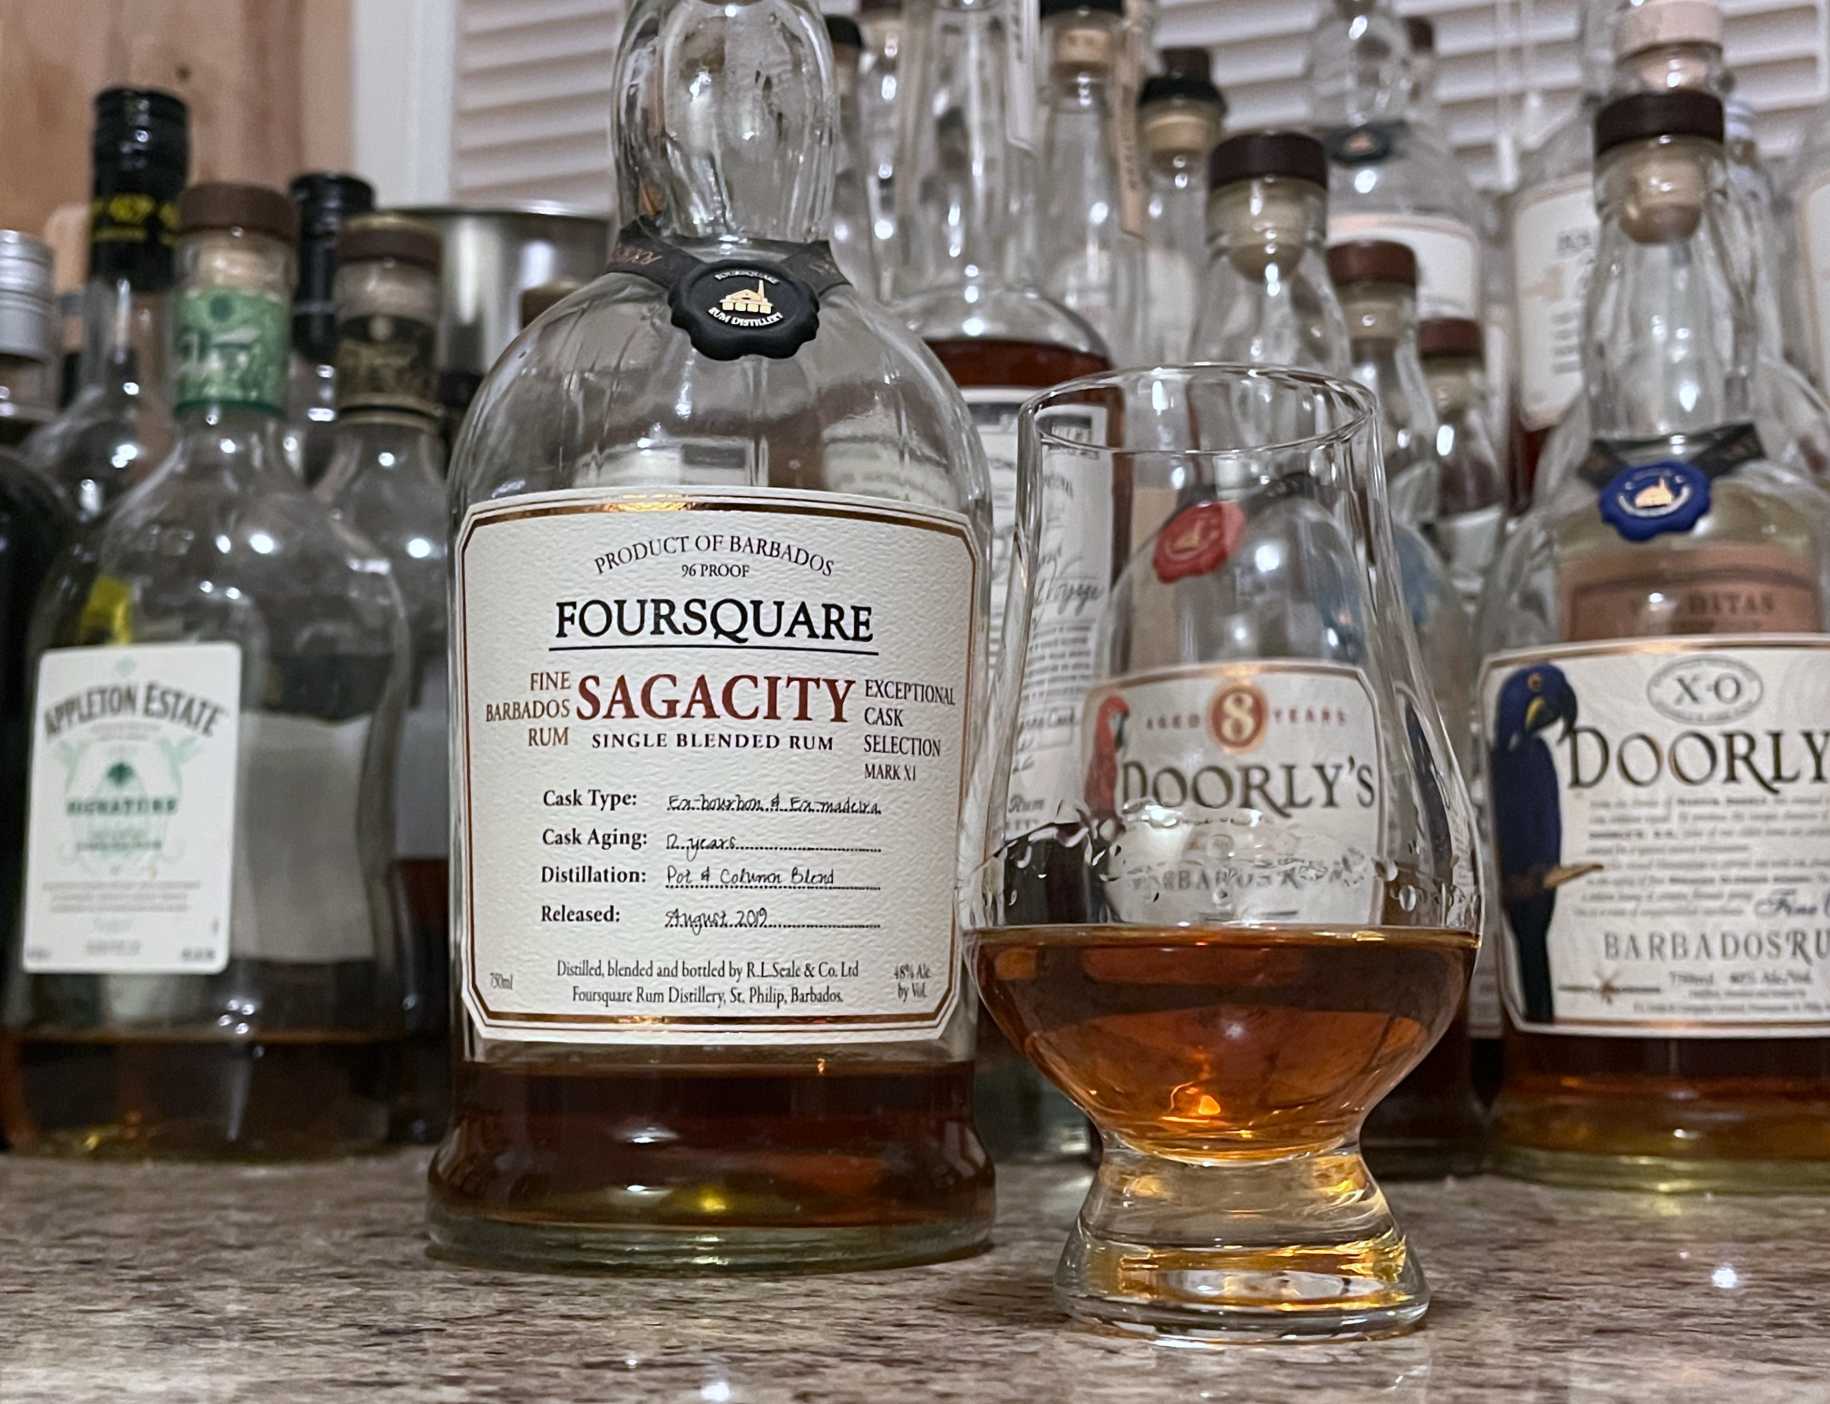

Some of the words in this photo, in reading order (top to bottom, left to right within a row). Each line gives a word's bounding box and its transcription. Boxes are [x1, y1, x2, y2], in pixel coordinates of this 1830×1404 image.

[708, 306, 731, 324] RUM
[594, 535, 690, 574] PRODUCT
[695, 534, 725, 552] OF
[730, 535, 835, 577] BARBADOS
[681, 564, 697, 578] 96
[700, 564, 750, 578] PROOF
[555, 597, 874, 644] FOURSQUARE
[530, 671, 571, 691] FINE
[864, 679, 956, 706] EXCEPTIONAL
[44, 682, 138, 740] APPLETON
[142, 679, 226, 738] ESTATE
[576, 673, 856, 723] SAGACITY
[486, 699, 571, 722] BARBADOS
[864, 707, 905, 728] CASK
[1146, 713, 1201, 730] AGED
[1219, 690, 1256, 742] 8
[1272, 704, 1349, 725] YEARS
[528, 726, 569, 747] RUM
[592, 733, 668, 749] SINGLE
[676, 733, 780, 750] BLENDED
[789, 735, 834, 751] RUM
[863, 734, 941, 757] SELECTION
[864, 763, 901, 780] MARK
[904, 767, 917, 782] XI
[1121, 755, 1376, 819] DOORLY'S
[543, 789, 583, 807] Cask
[588, 789, 638, 811] Type:
[542, 827, 582, 846] Cask
[587, 828, 648, 850] Aging:
[541, 865, 647, 884] Distillation:
[666, 865, 693, 885] Pot
[720, 868, 783, 885] Column
[791, 866, 834, 884] Blend
[541, 904, 621, 923] Released:
[664, 907, 728, 936] August
[735, 907, 768, 928] 2019
[1603, 930, 1783, 962] BARBADOS
[557, 959, 605, 979] Distilled,
[607, 960, 654, 978] blended
[657, 961, 678, 978] and
[682, 960, 726, 979] bottled
[729, 961, 743, 983] by
[804, 963, 815, 978] &
[818, 962, 838, 978] Co.
[841, 961, 859, 978] Ltd
[572, 985, 633, 1008] Foursquare
[636, 986, 665, 1004] Rum
[668, 986, 726, 1008] Distillery,
[730, 986, 745, 1004] St.
[749, 985, 788, 1009] Philip,
[898, 984, 909, 1002] by
